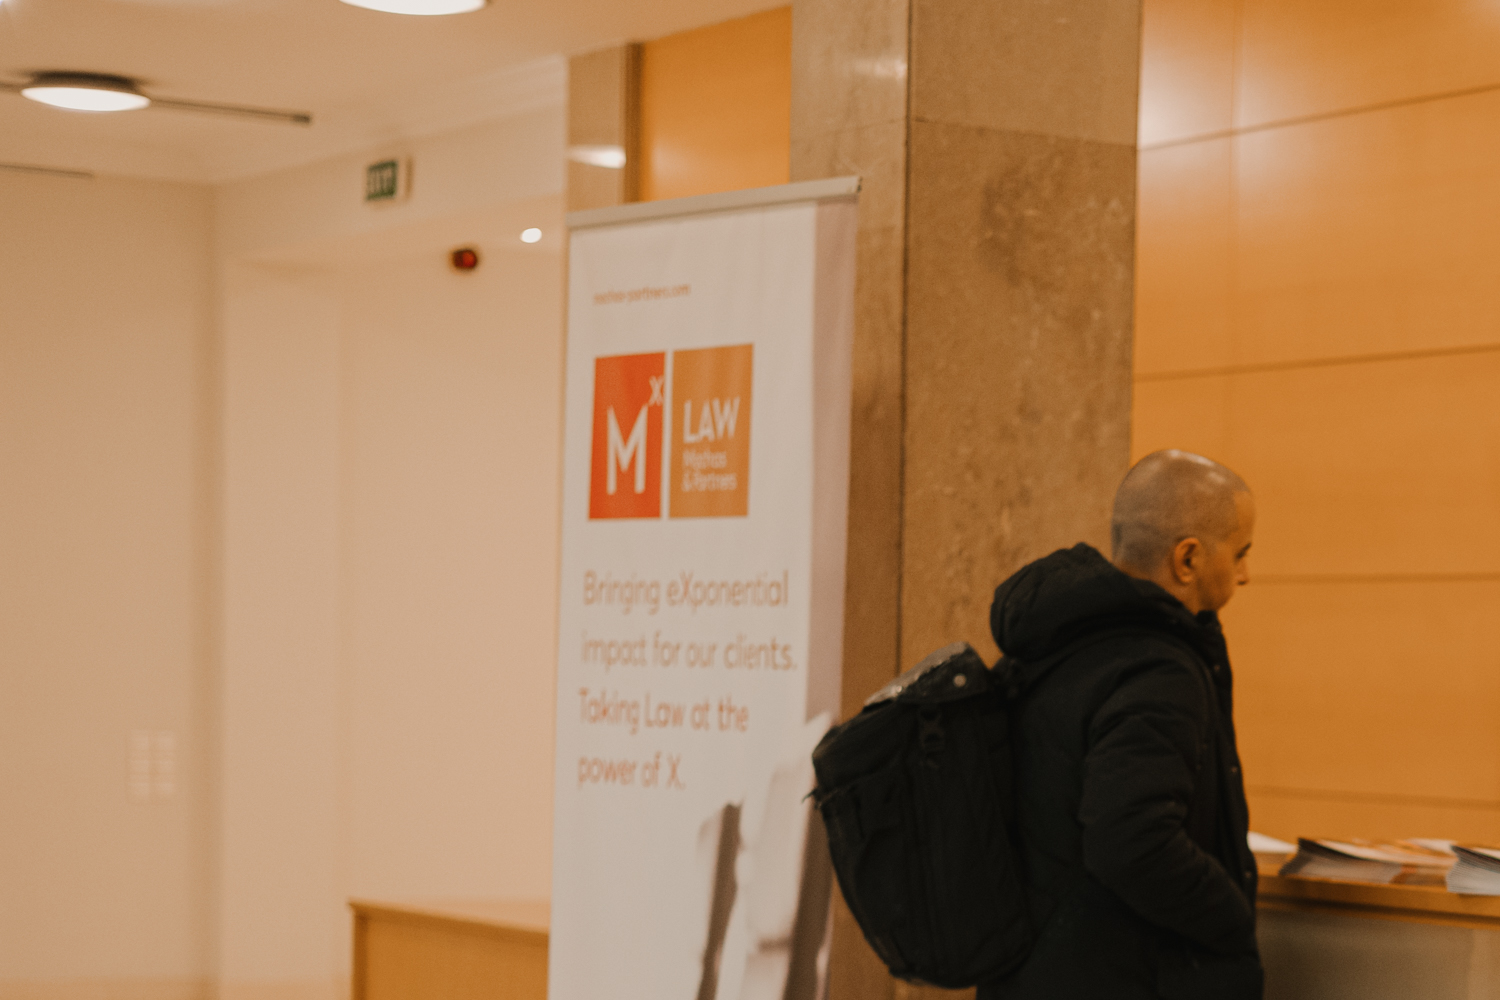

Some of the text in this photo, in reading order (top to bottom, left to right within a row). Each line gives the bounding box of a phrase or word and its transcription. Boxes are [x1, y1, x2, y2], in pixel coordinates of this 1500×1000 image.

[683, 396, 740, 444] LAW
[607, 402, 648, 495] M
[584, 569, 789, 615] Bringing eXponential
[581, 629, 797, 673] impact for our clients.
[578, 686, 748, 736] Taking Law at the
[578, 756, 636, 790] power
[641, 750, 661, 788] of
